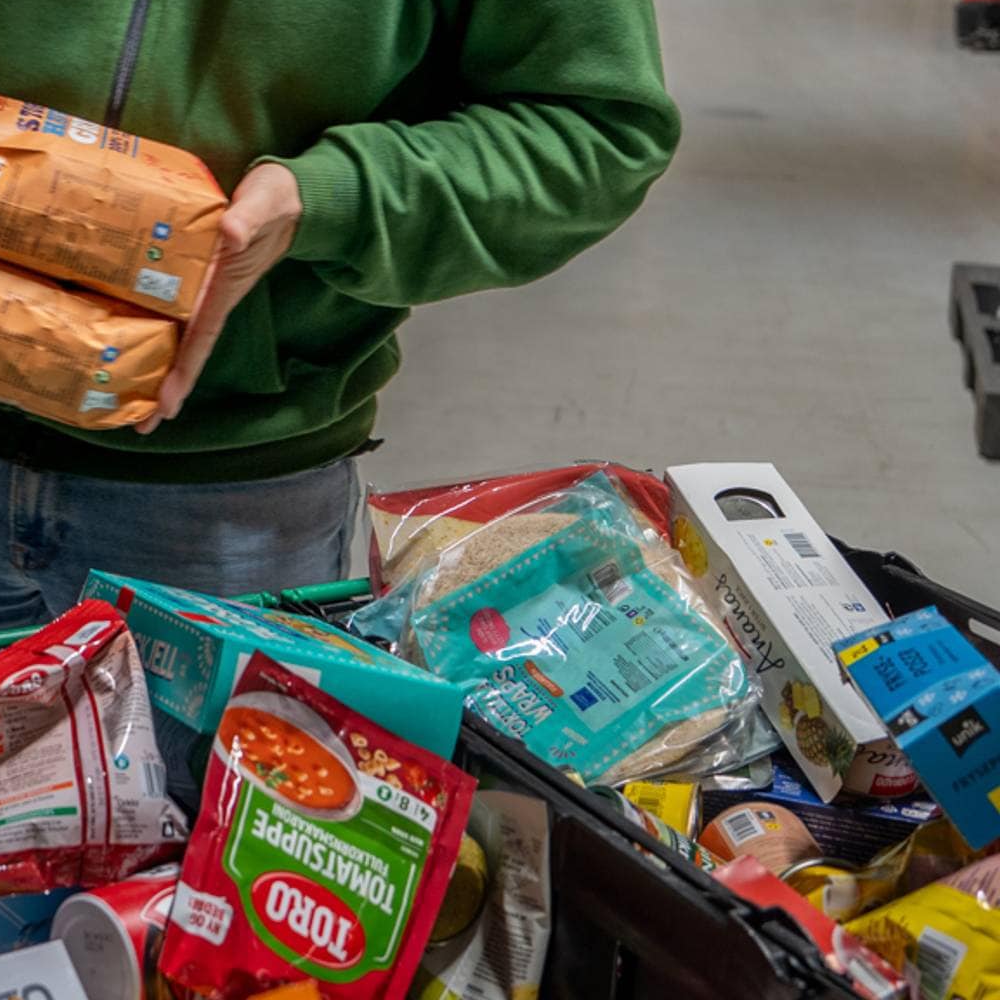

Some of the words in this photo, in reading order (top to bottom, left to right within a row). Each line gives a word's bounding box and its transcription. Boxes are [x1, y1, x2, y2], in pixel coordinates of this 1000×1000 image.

[716, 573, 786, 676] Ananas
[492, 664, 556, 726] WRAPS
[950, 719, 987, 750] unik
[397, 794, 411, 811] 8
[420, 807, 430, 822] 4
[250, 808, 399, 917] TOMATSUPPE
[270, 802, 391, 879] FULLKORNSMAKARONI
[265, 879, 355, 964] TORO
